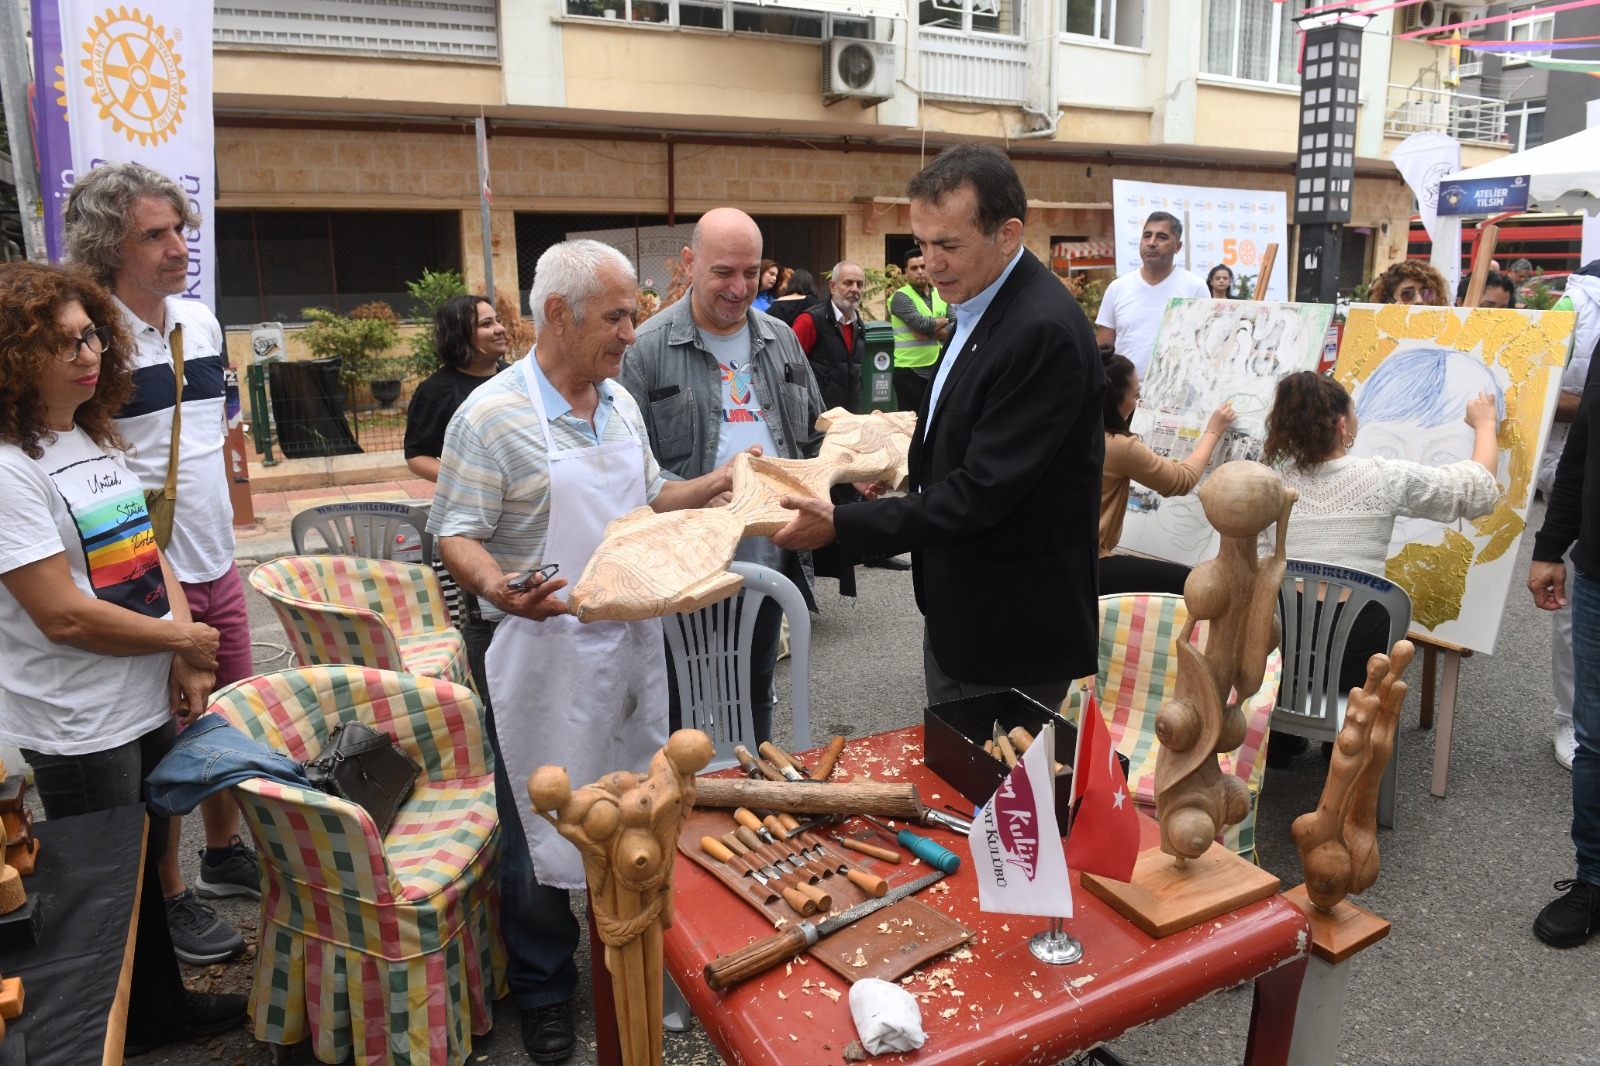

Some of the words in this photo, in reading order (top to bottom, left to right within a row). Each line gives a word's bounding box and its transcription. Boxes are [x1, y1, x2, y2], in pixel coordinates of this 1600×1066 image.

[93, 39, 109, 98] ROTARY
[154, 34, 179, 129] INTERNATIONAL
[1474, 187, 1508, 198] ATELİER
[1477, 198, 1505, 207] TILSIM
[88, 471, 121, 494] United
[116, 502, 144, 524] States
[984, 801, 994, 831] NAT
[986, 829, 1007, 888] KULÜBÜ
[1002, 810, 1036, 882] Kulüp
